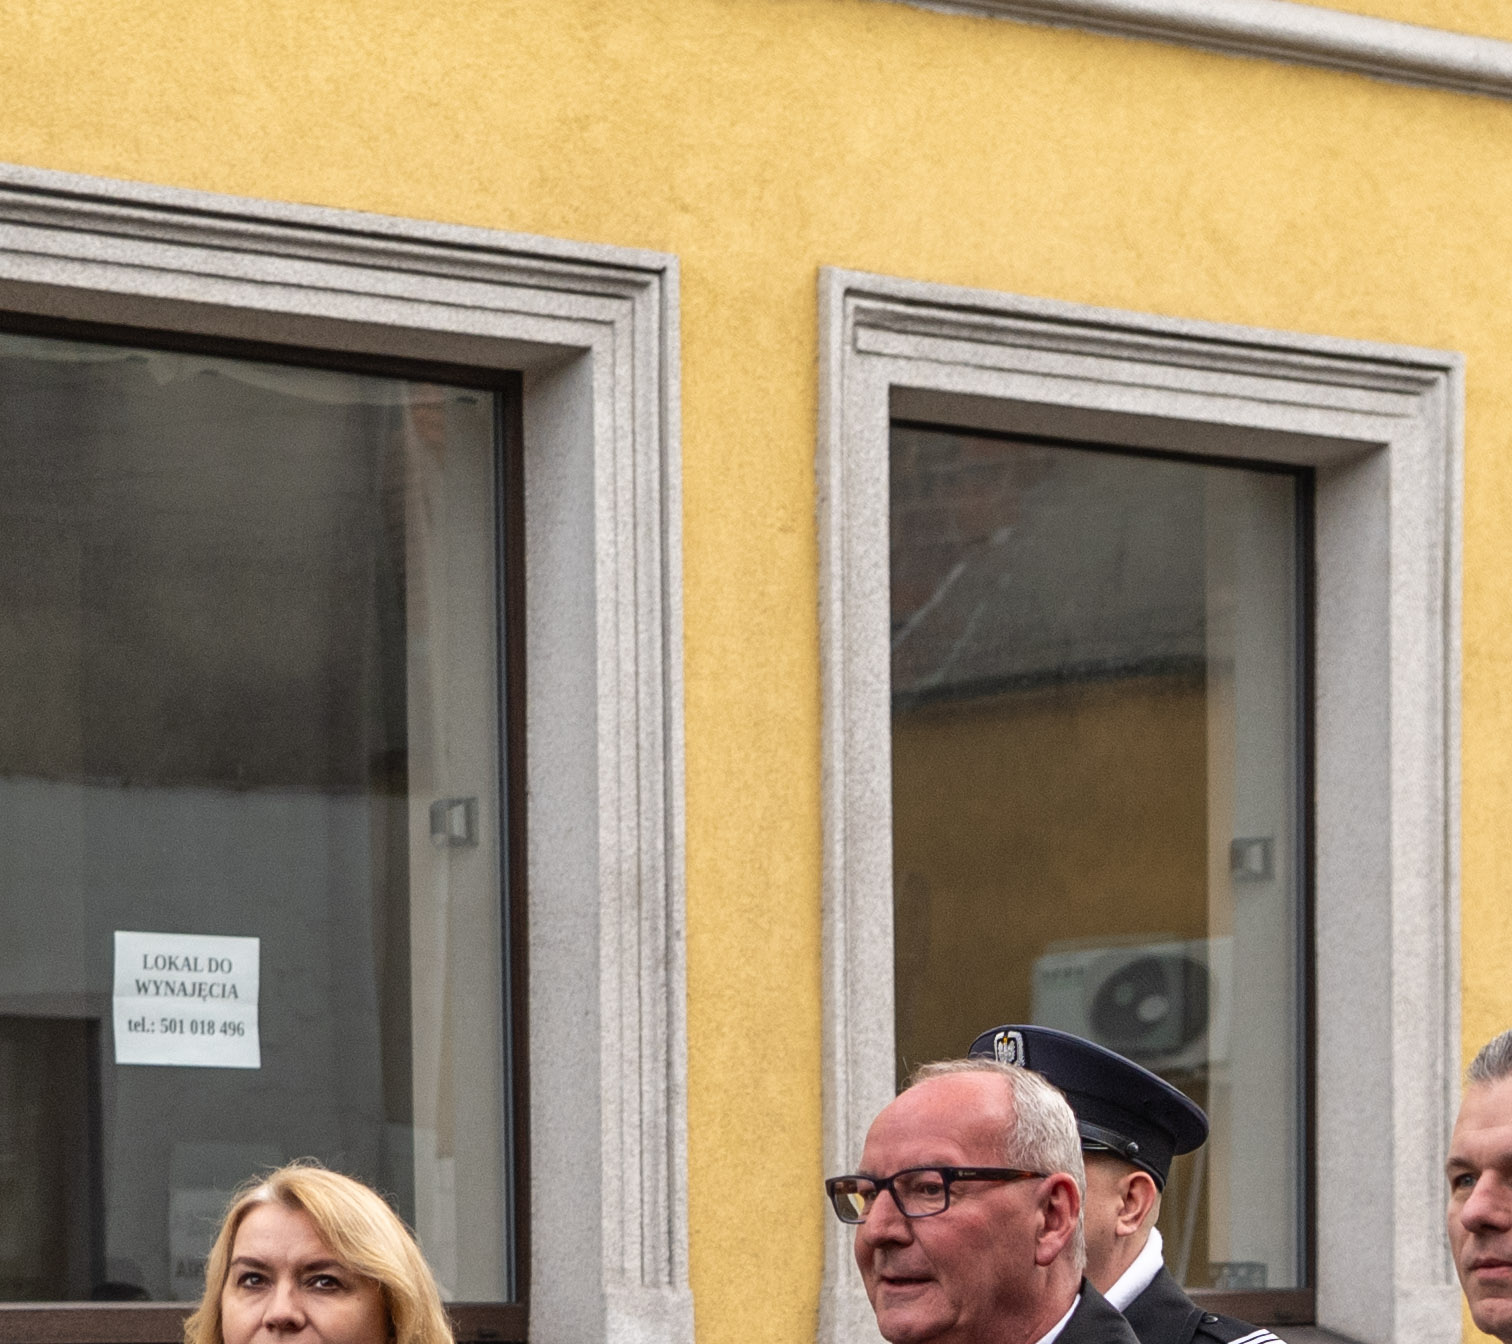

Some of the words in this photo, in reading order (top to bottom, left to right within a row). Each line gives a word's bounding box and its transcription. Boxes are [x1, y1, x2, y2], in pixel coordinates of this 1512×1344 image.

[143, 953, 204, 972] LOKAL
[208, 957, 233, 974] DO
[135, 979, 239, 1002] WYNAJĘCIA
[128, 1016, 155, 1034] tel.:
[160, 1018, 184, 1034] 501
[190, 1019, 215, 1036] 018
[219, 1021, 245, 1037] 496
